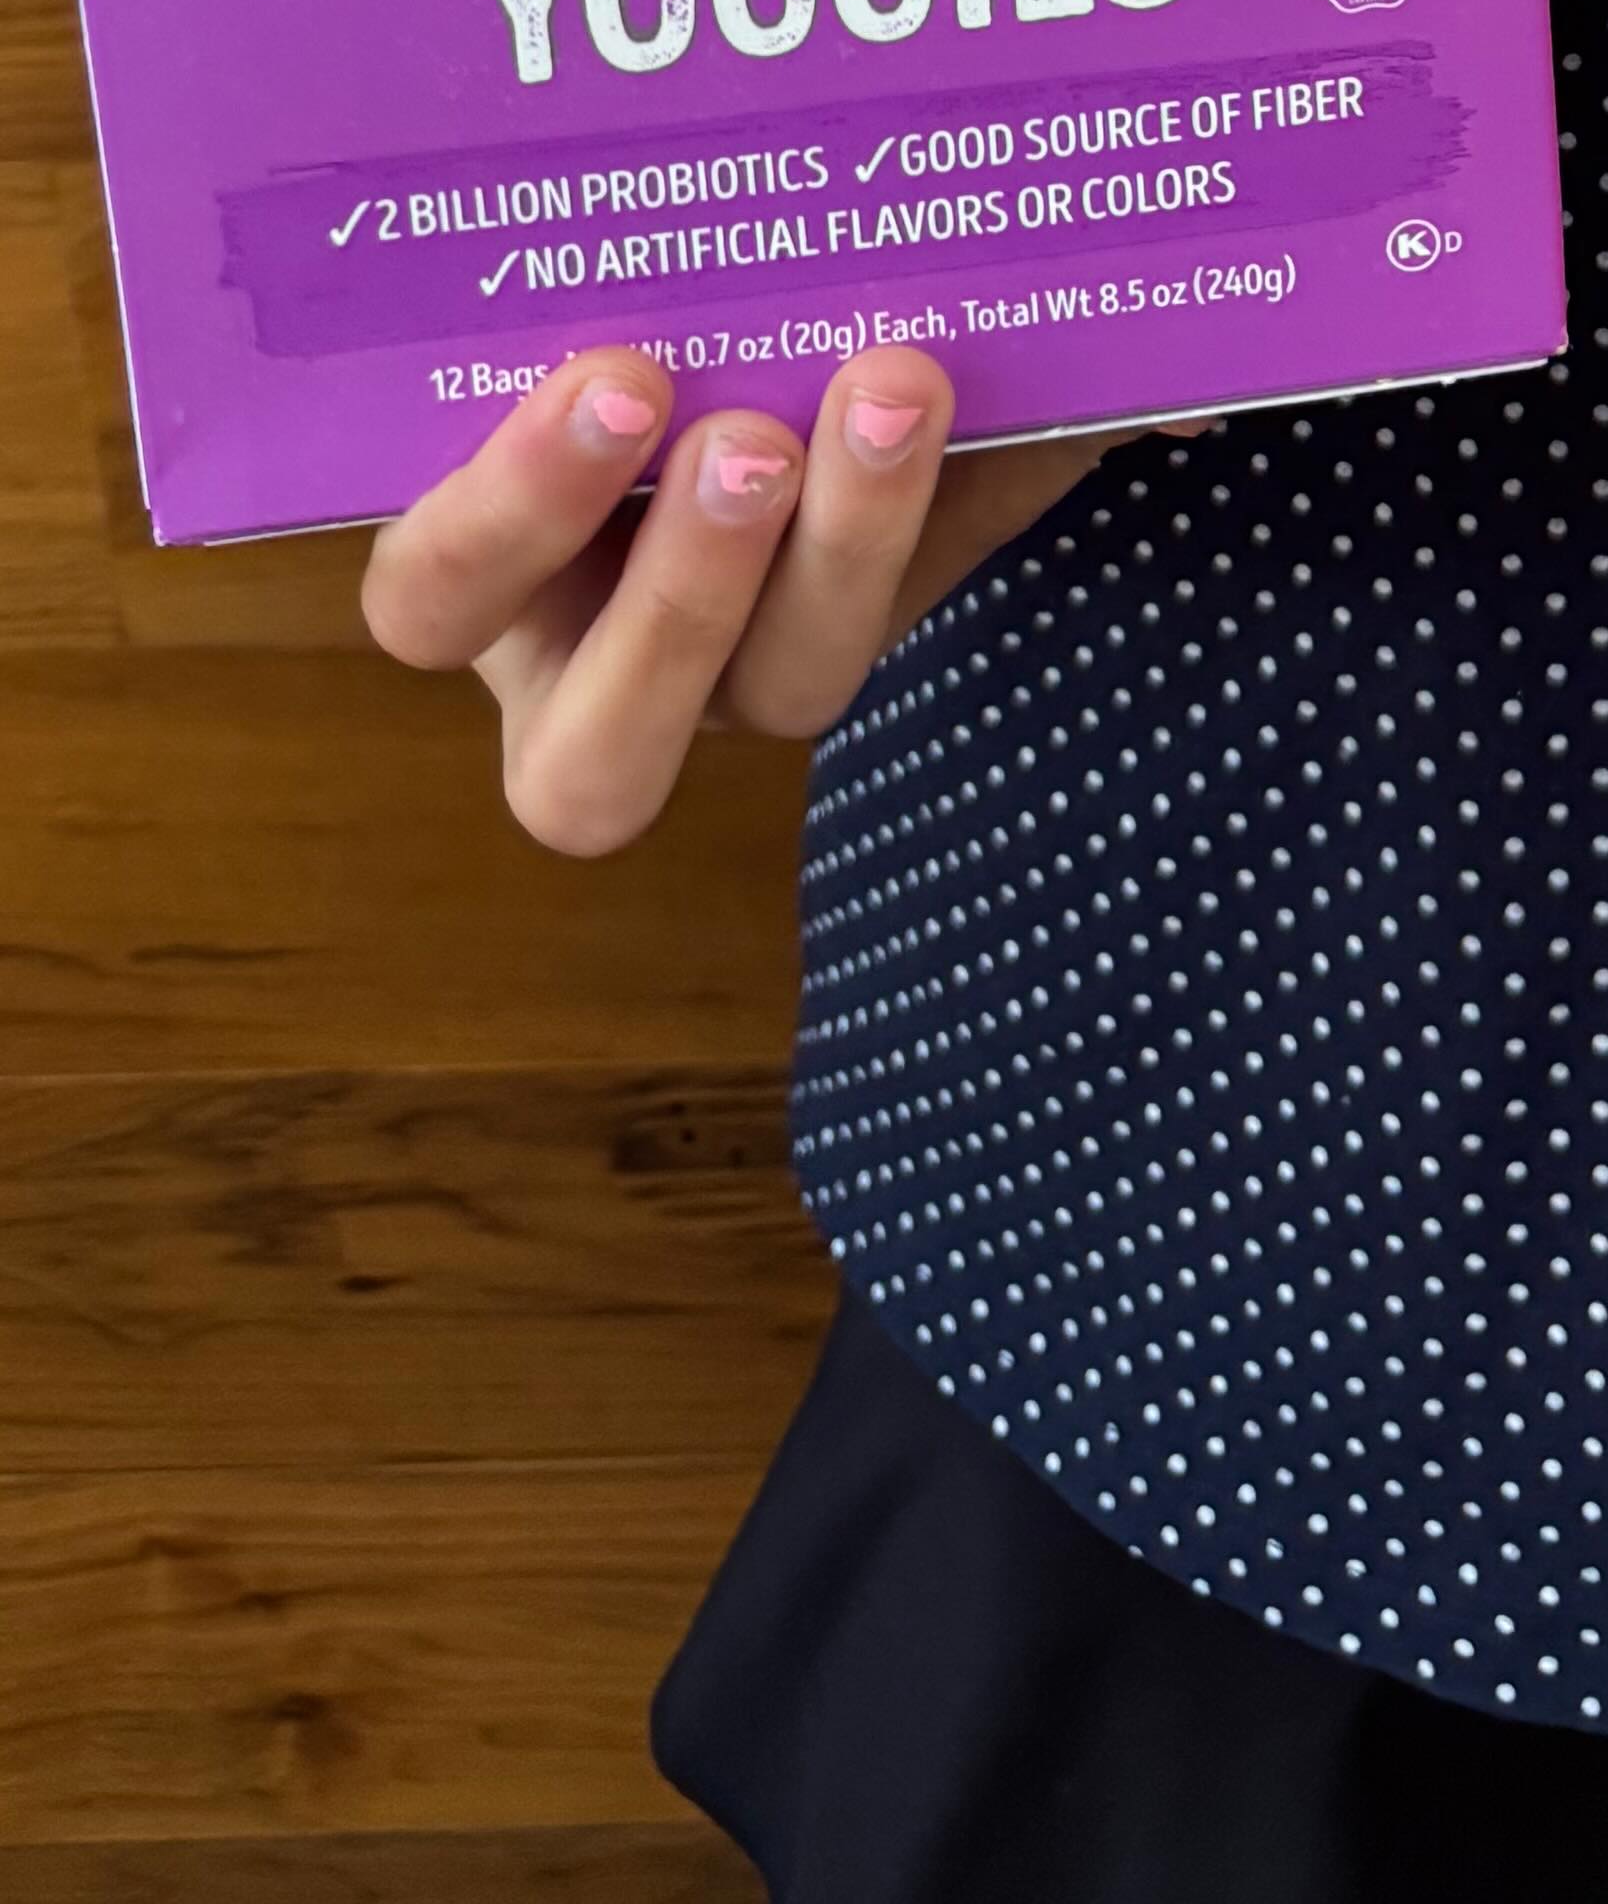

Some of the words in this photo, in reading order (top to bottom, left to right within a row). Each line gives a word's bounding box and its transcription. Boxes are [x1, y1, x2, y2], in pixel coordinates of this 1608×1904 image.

[374, 198, 402, 242] 2
[409, 176, 572, 237] BILLION
[582, 145, 830, 216] PROBIOTICS
[900, 123, 1015, 178] GOOD
[1024, 100, 1183, 161] SOURCE
[1191, 92, 1242, 139] OF
[1251, 75, 1365, 132] FIBER
[525, 243, 586, 291] NO
[595, 215, 820, 284] ARTIFICIAL
[826, 190, 1010, 254] FLAVORS
[1017, 185, 1073, 230] OR
[1081, 160, 1237, 221] COLORS
[430, 366, 466, 401] 12
[686, 332, 730, 370] 0.7
[738, 330, 775, 362] oz
[779, 311, 867, 361] (20g)
[874, 307, 958, 347] Each,
[961, 292, 1040, 333] Total
[1044, 285, 1095, 325] Wt
[1100, 278, 1146, 314] 8.5
[1152, 278, 1188, 308] oz
[1193, 254, 1297, 306] (240g)
